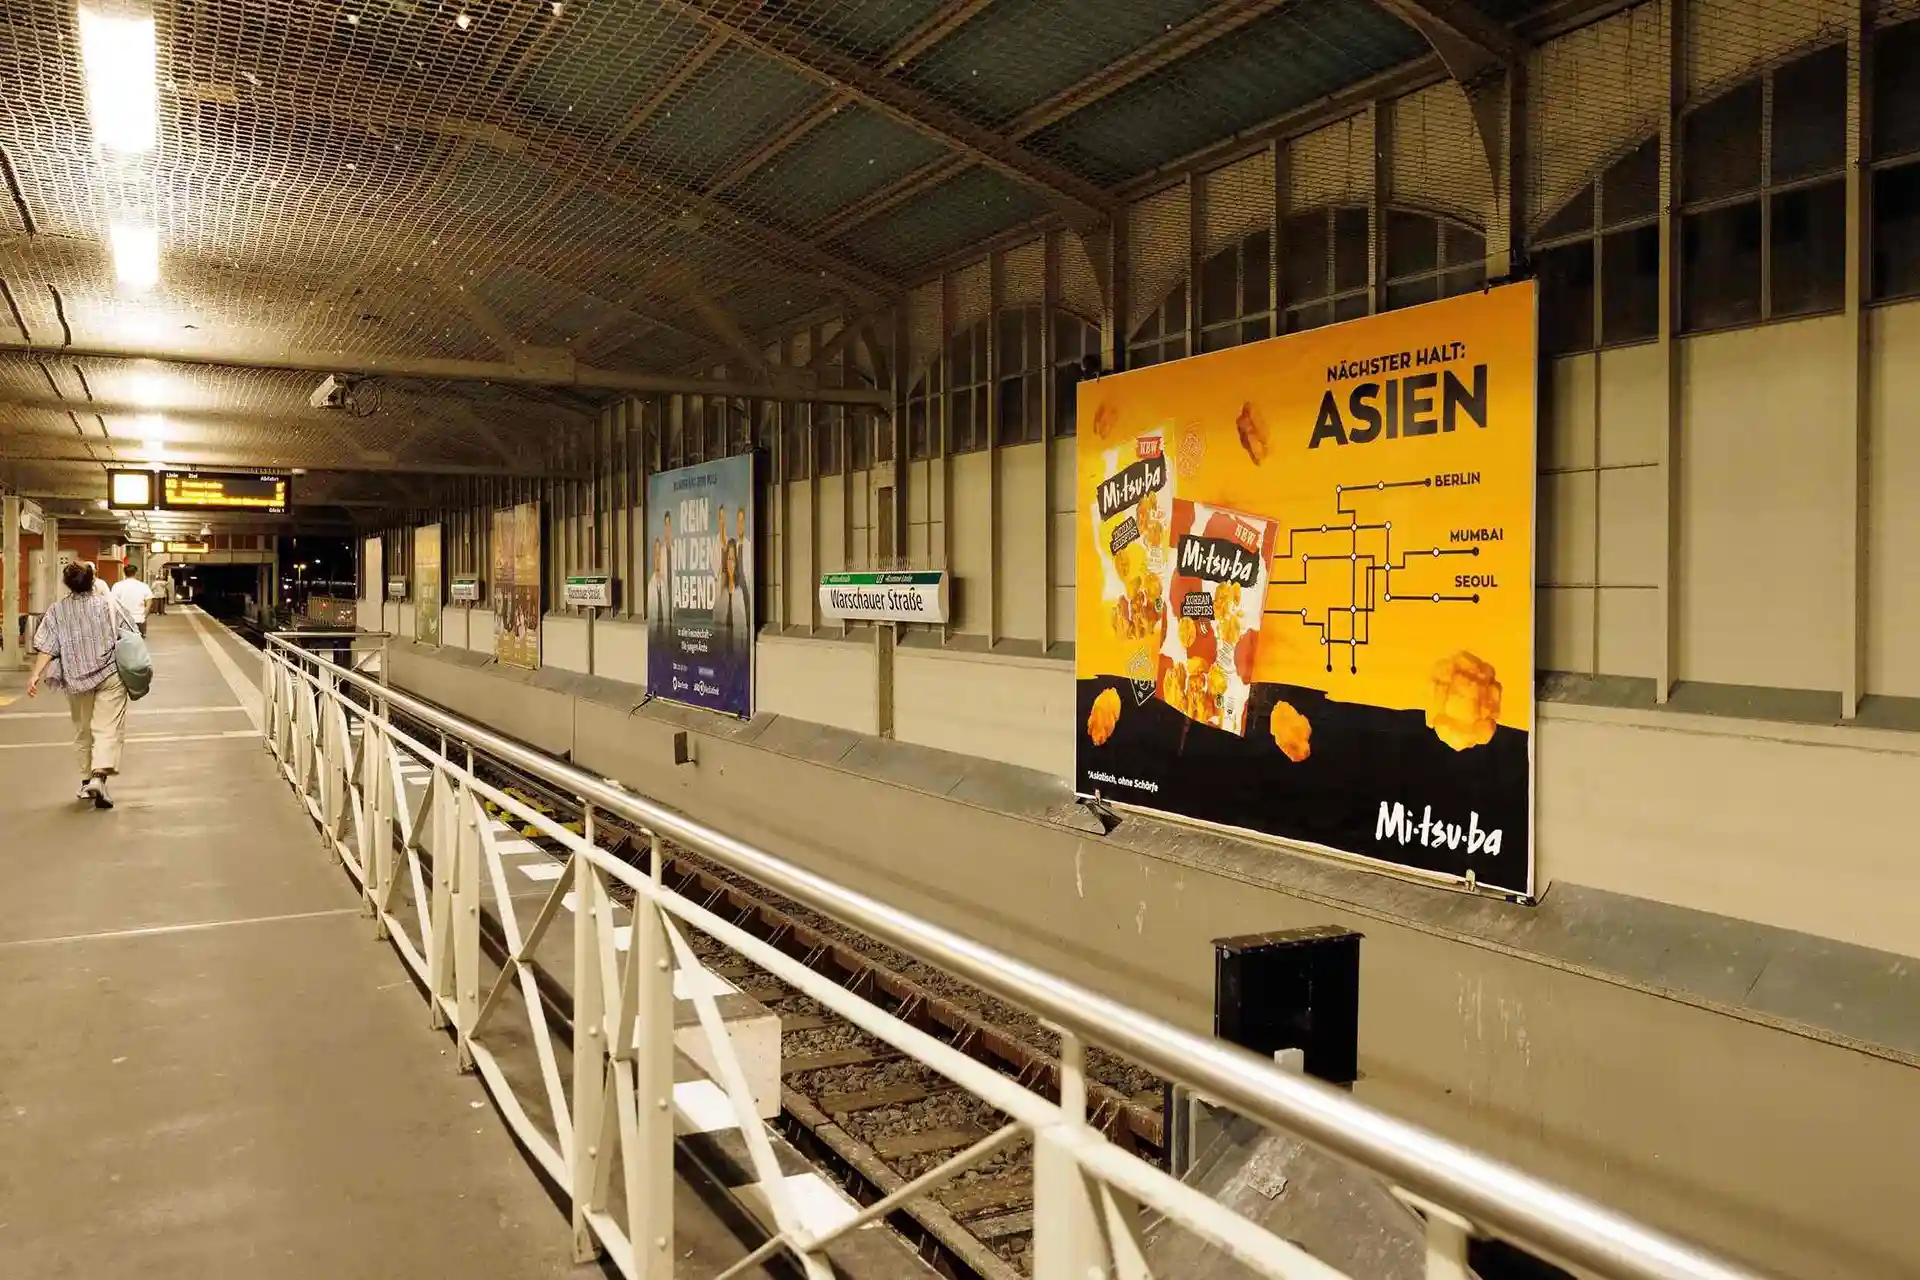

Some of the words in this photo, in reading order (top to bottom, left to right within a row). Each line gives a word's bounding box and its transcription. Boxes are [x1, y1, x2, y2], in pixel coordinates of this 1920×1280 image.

[1327, 352, 1411, 382] NÄCHSTER
[1416, 342, 1466, 367] HALT:
[1308, 364, 1488, 449] ASIEN
[1435, 472, 1481, 487] BERLIN
[680, 497, 709, 535] REIN
[1450, 528, 1504, 542] MUMBAI
[1455, 575, 1498, 588] SEOUL
[673, 575, 716, 610] ABEND
[830, 587, 885, 610] Warschauer
[888, 587, 924, 612] Straße
[1185, 594, 1211, 605] KOREAN
[1182, 605, 1214, 616] CRISPIES
[1118, 776, 1133, 787] ohne
[1134, 779, 1159, 793] Schärfe
